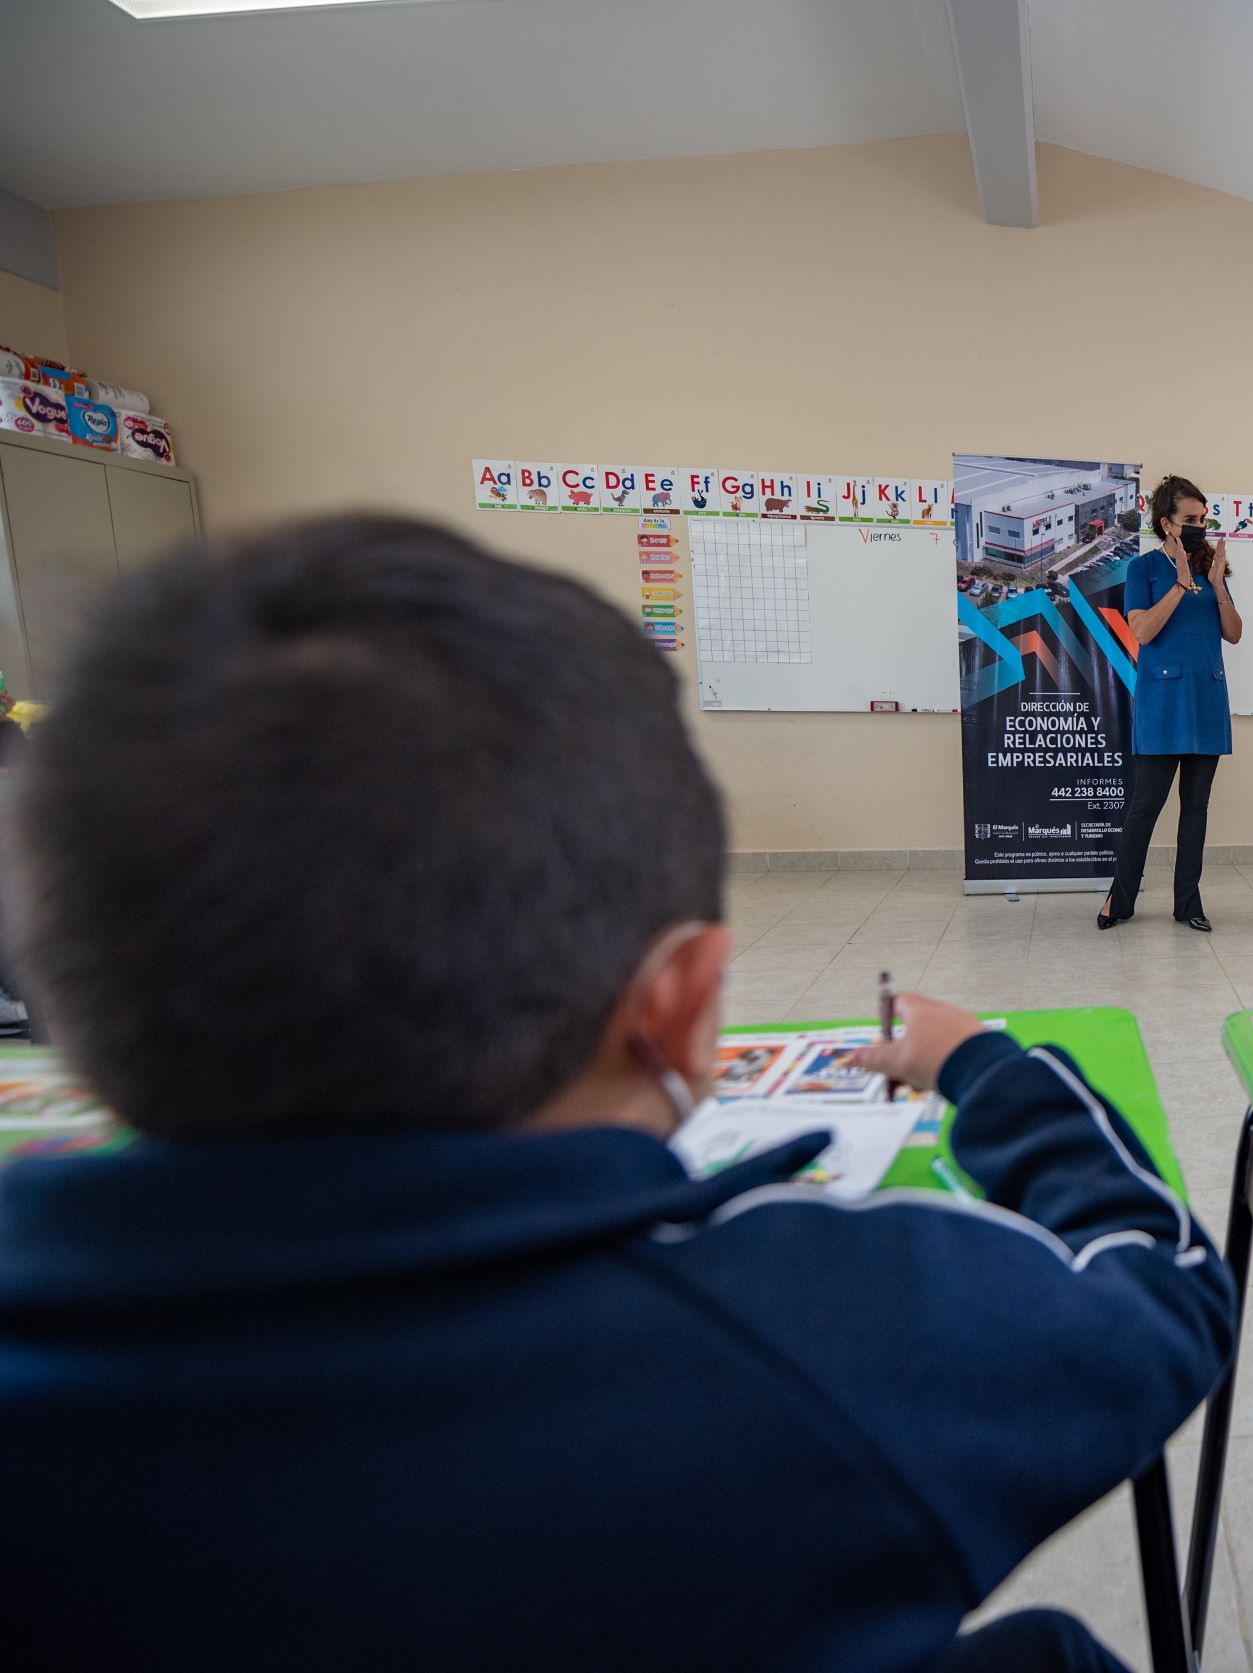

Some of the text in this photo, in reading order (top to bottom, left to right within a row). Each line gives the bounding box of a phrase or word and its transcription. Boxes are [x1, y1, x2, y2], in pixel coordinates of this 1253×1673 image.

[86, 414, 108, 428] Regio
[480, 466, 511, 486] Aa
[521, 468, 552, 488] Bb
[562, 470, 595, 489] Cc
[604, 472, 636, 490] Dd
[644, 474, 674, 492] Ee
[690, 475, 710, 492] Ff
[721, 476, 754, 500] Gg
[761, 478, 792, 498] Hh
[878, 484, 906, 502] Kk
[858, 528, 902, 544] Viernes
[1021, 700, 1090, 712] DIRECCIÓN DE
[1006, 714, 1100, 730] ECONOMÍA Y
[1004, 734, 1106, 748] RELACIONES
[988, 752, 1122, 766] EMPRESARIALES
[1052, 787, 1124, 796] 442 238 8400
[1088, 802, 1124, 810] Ext. 2307
[1028, 826, 1060, 834] Marqués
